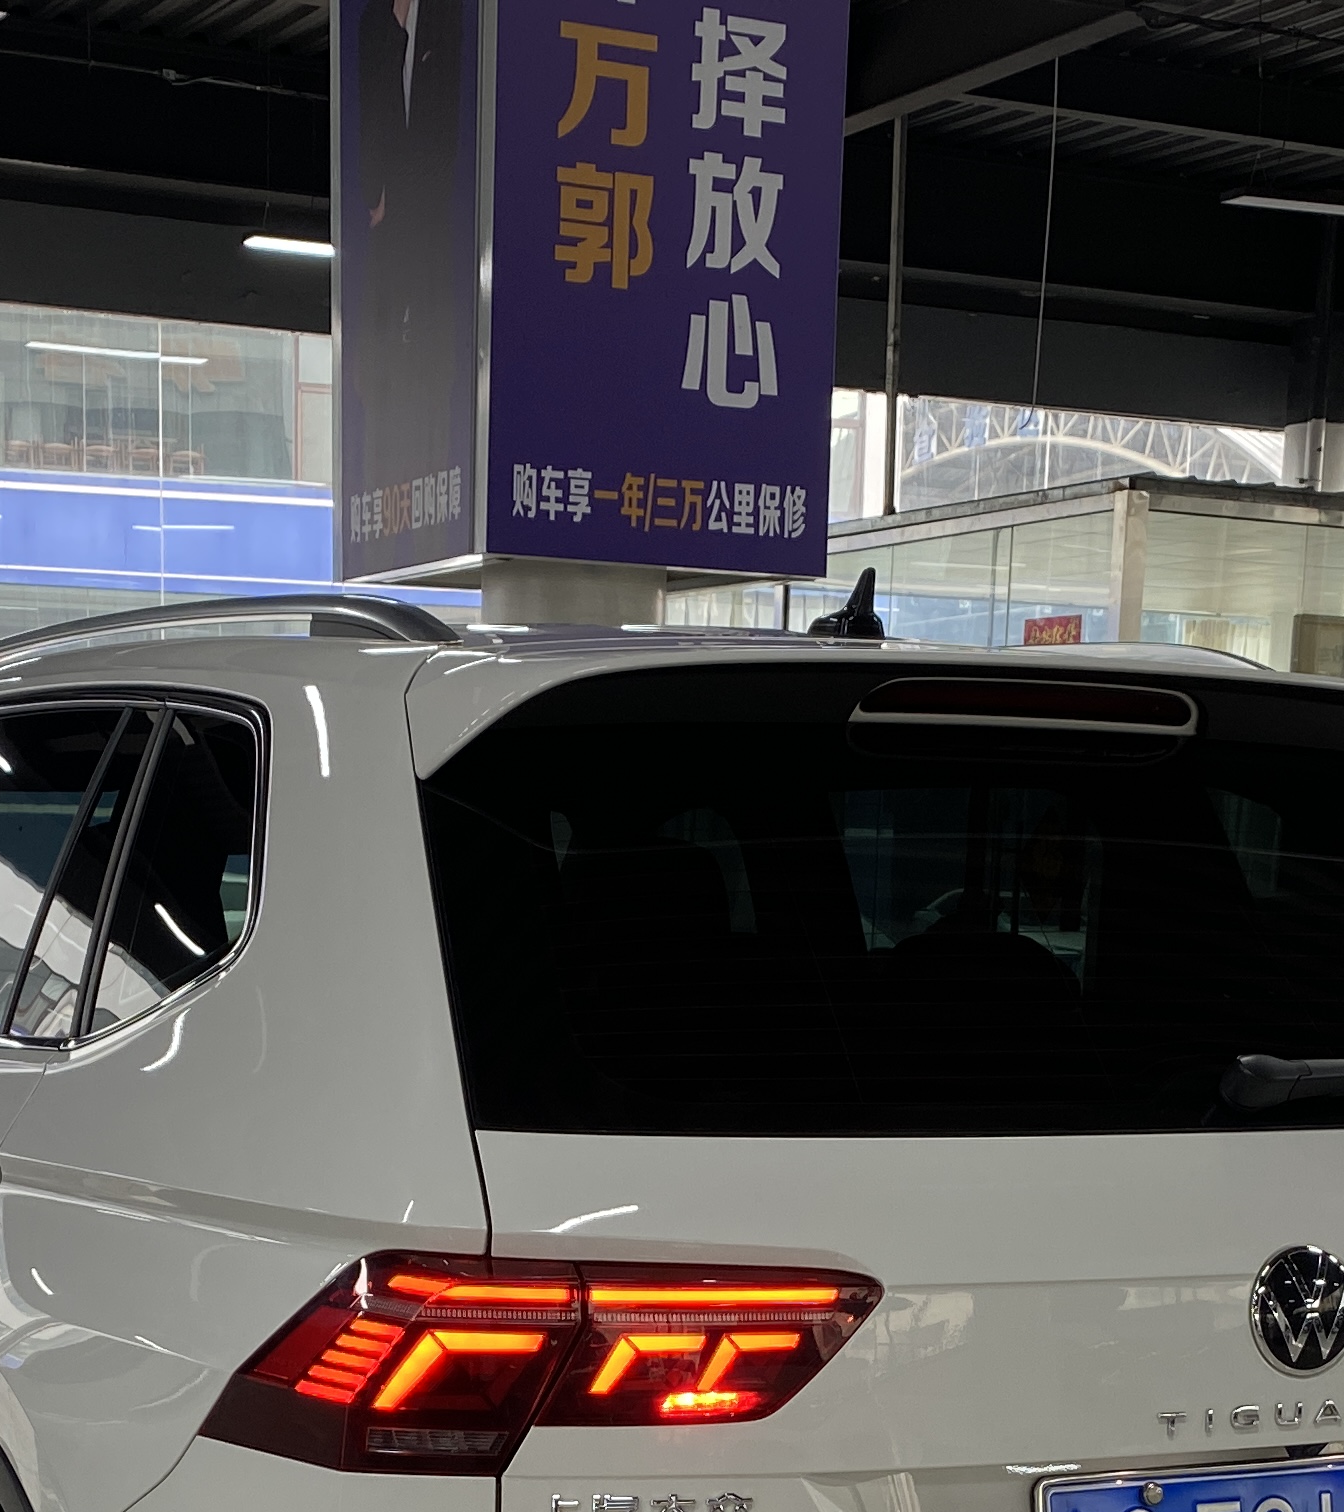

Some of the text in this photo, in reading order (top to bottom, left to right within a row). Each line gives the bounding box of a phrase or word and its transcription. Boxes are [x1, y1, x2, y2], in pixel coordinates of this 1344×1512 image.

[553, 20, 659, 290] 万郭
[681, 7, 788, 409] 择放心
[350, 465, 461, 543] 购车享90天回购保障
[512, 463, 807, 538] 购车享一年/三万公里保修
